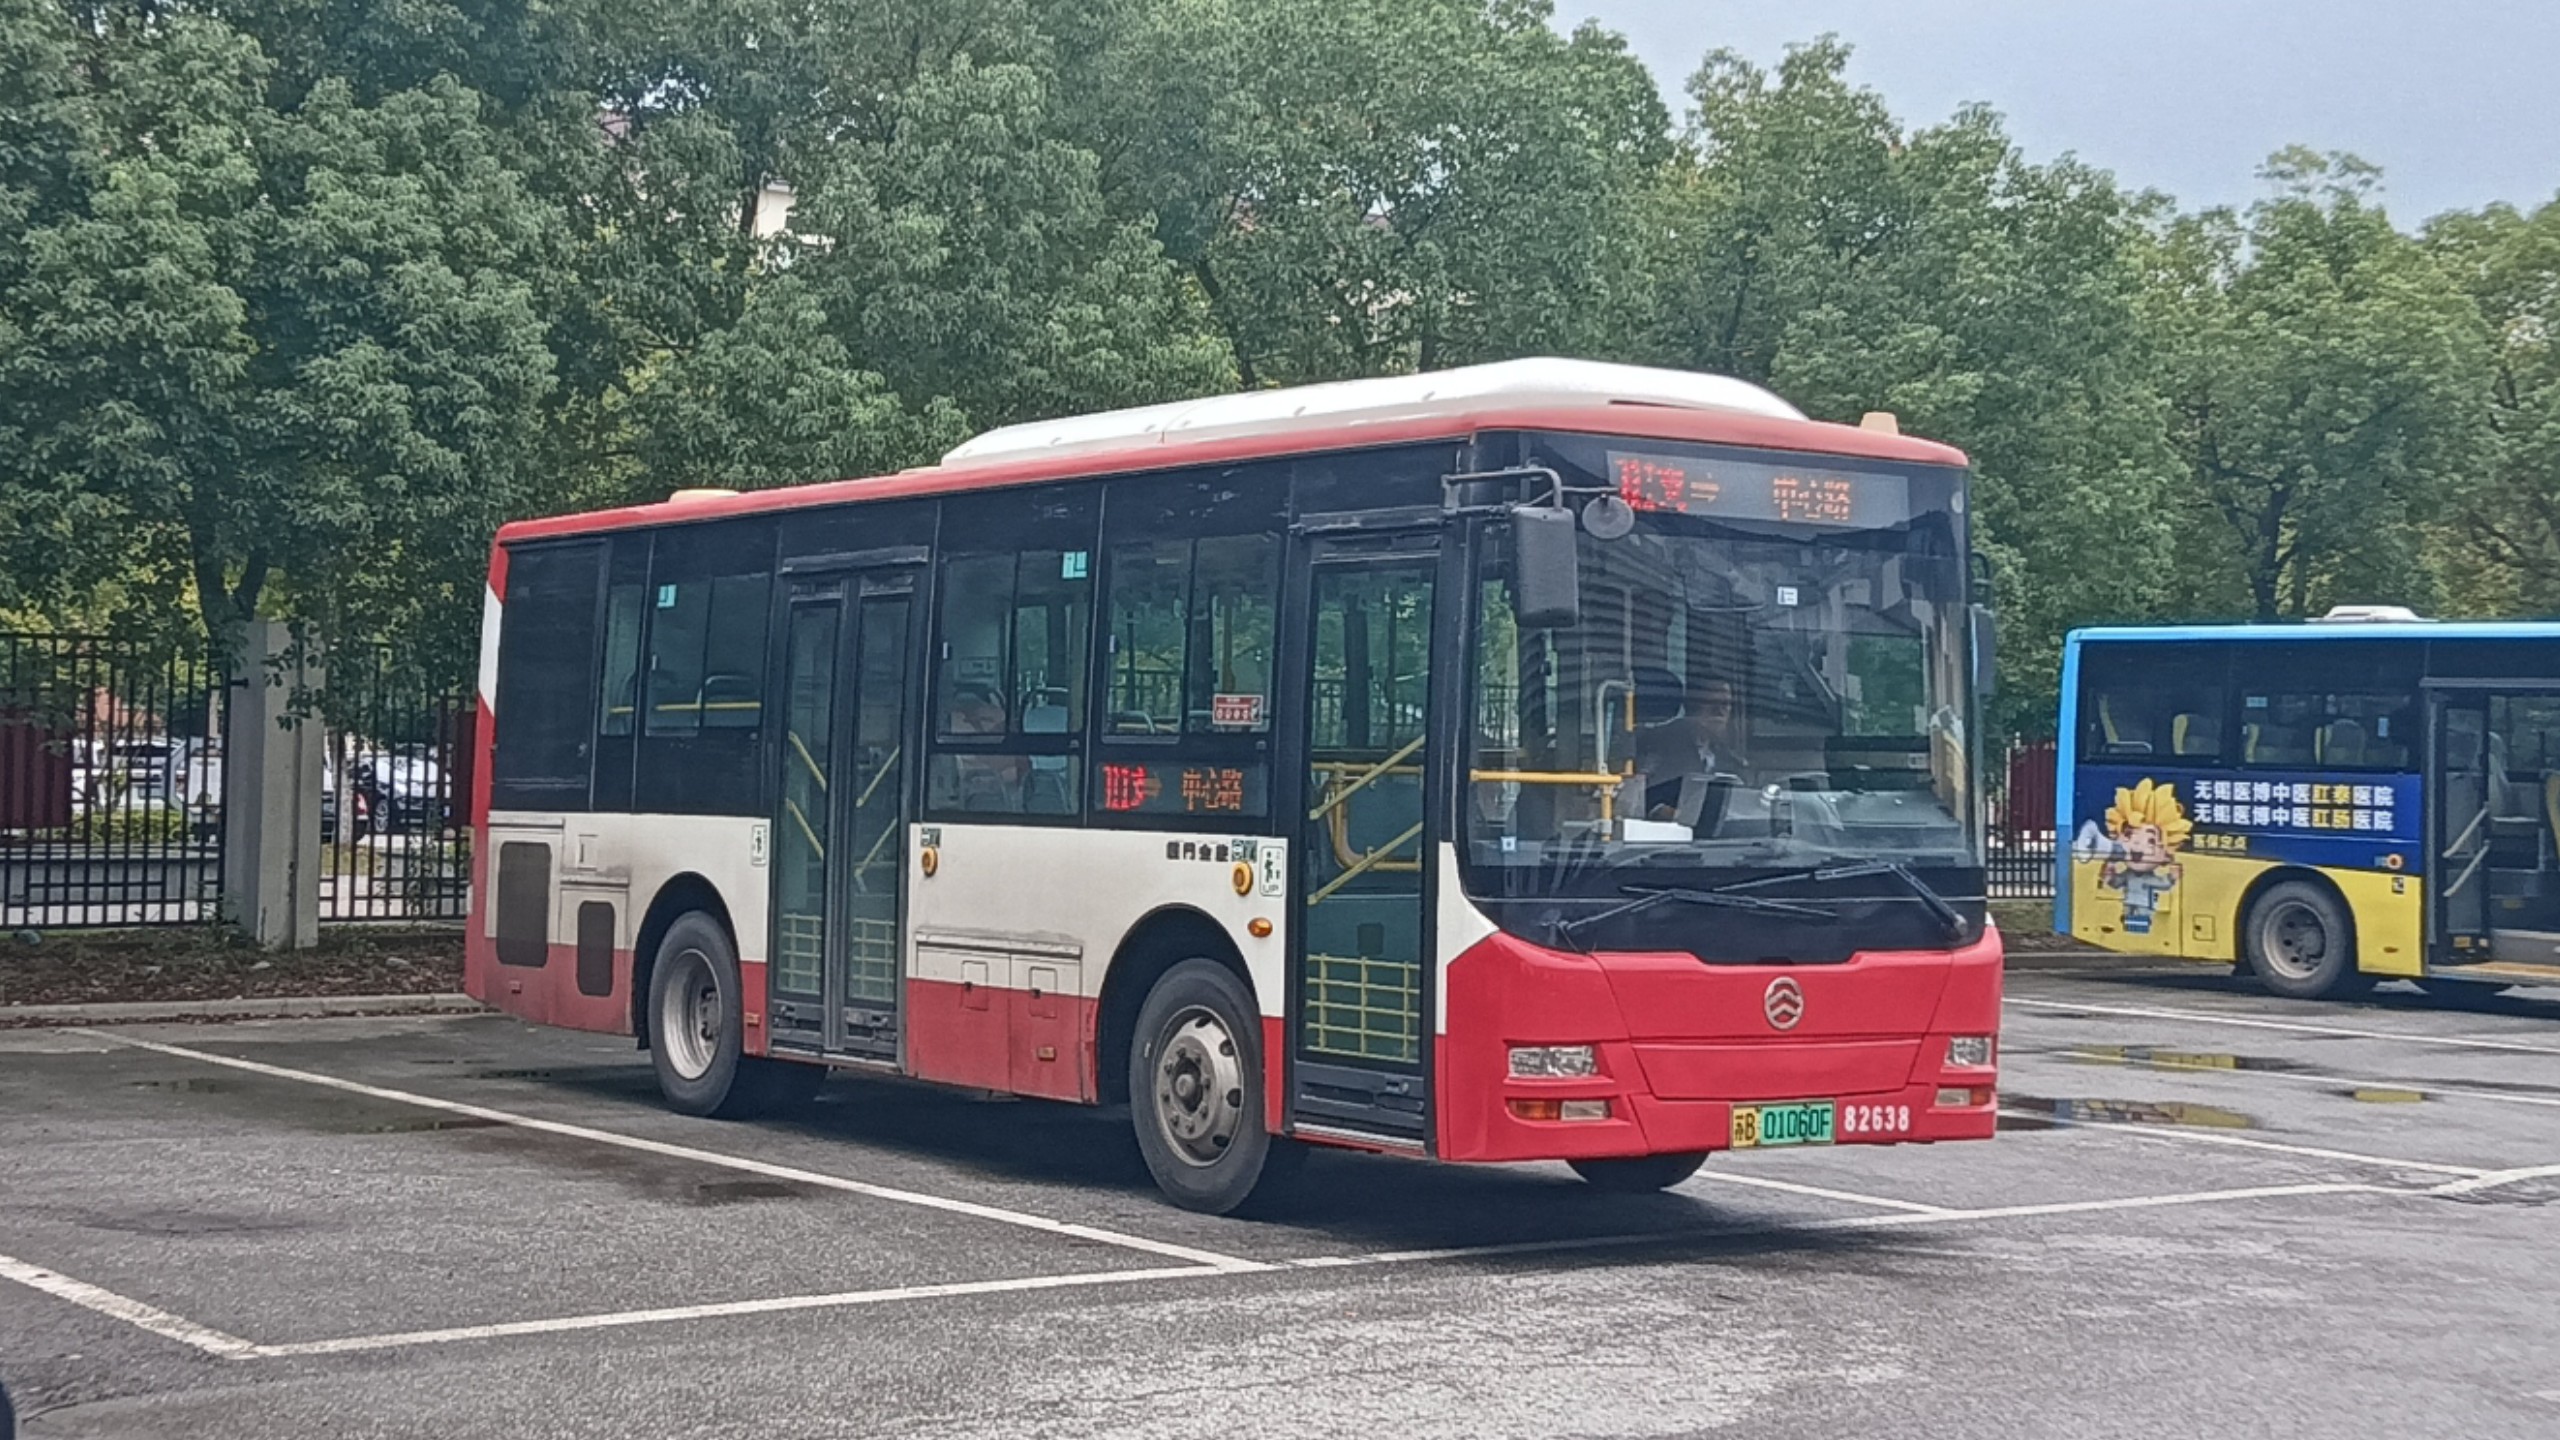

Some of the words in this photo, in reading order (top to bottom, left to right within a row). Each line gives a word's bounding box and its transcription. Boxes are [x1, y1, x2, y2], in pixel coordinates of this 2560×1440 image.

[1182, 766, 1243, 811] 中心路
[1844, 1105, 1910, 1132] 82638
